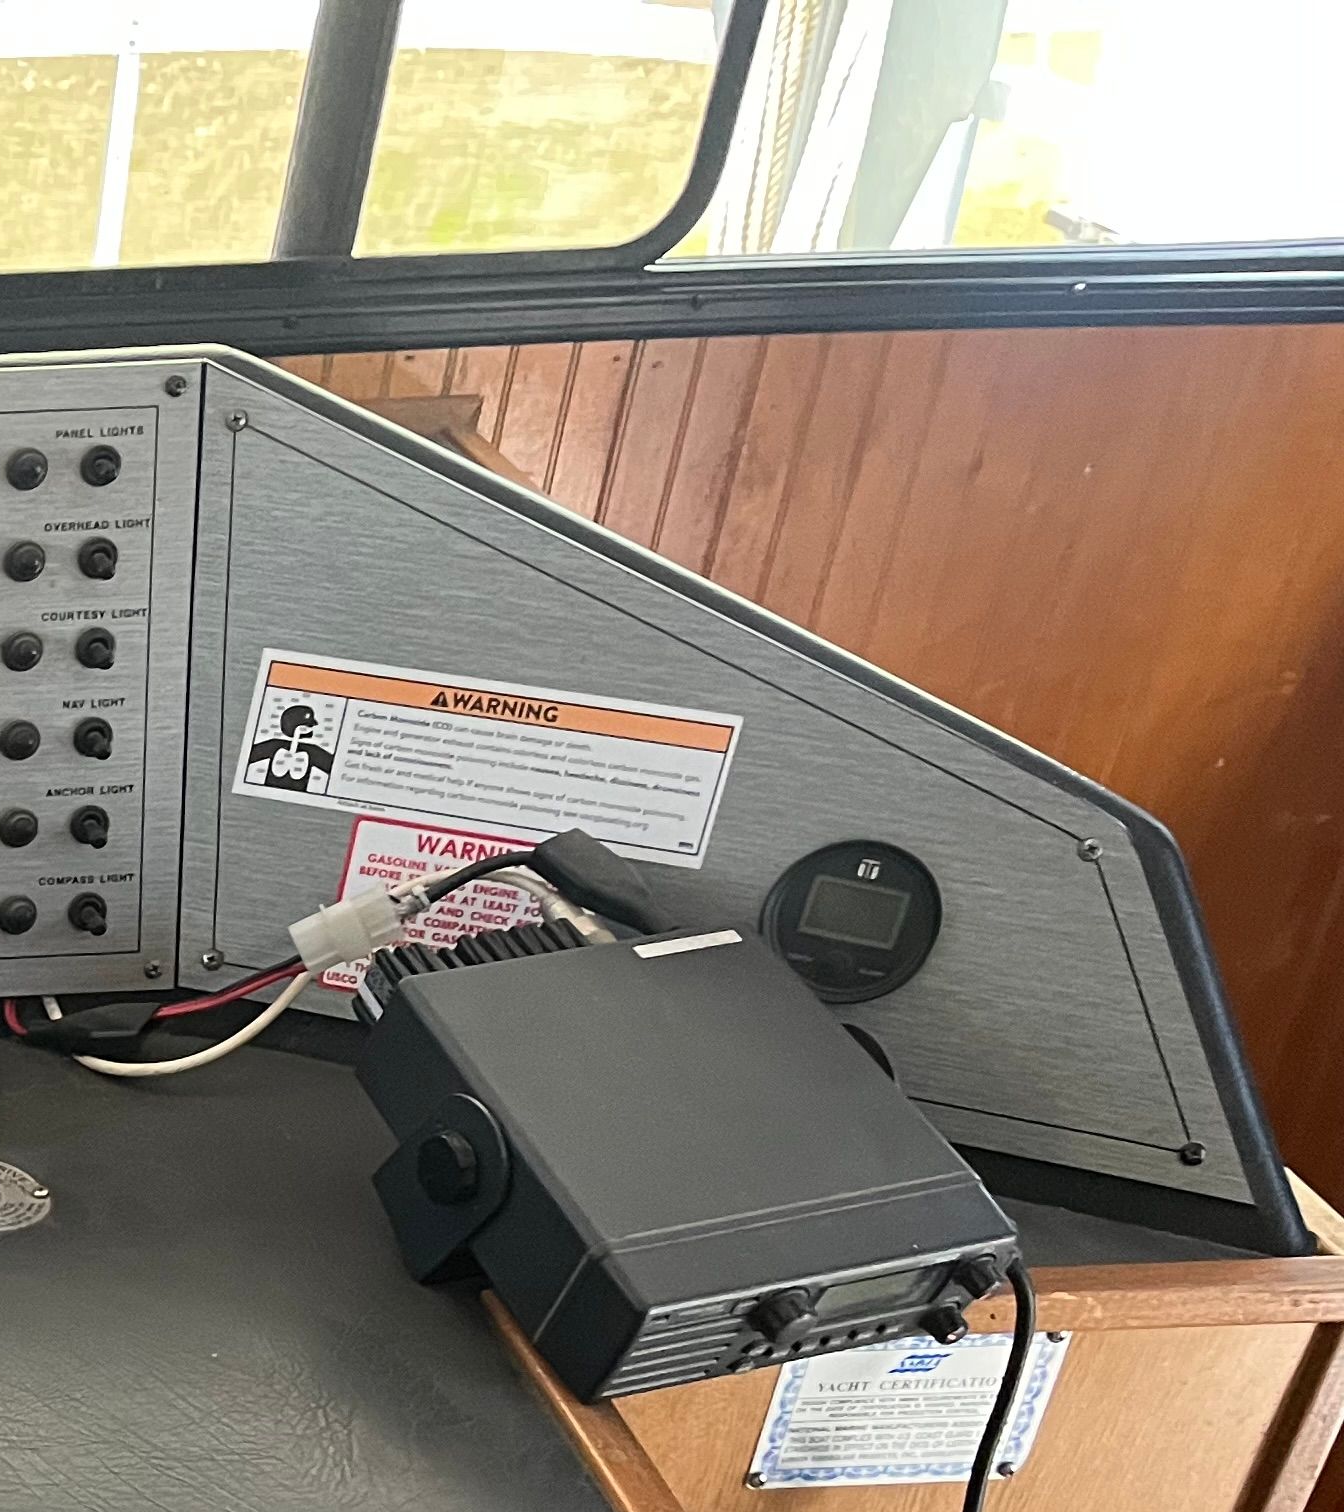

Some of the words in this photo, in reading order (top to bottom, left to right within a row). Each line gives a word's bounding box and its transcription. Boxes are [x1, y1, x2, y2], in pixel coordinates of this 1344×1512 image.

[56, 429, 93, 438] PANEL
[100, 426, 144, 437] LIGHTS
[44, 520, 109, 532] OVERHEAD
[115, 519, 150, 529] LIGHT
[41, 611, 105, 621] COURTESY
[112, 608, 147, 618] LIGHT
[62, 700, 85, 709] NAV
[91, 698, 125, 708] LIGHT
[453, 692, 559, 722] WARNING
[46, 787, 94, 797] ANCHOR
[100, 785, 134, 795] LIGHT
[418, 834, 512, 861] WARN
[368, 854, 427, 871] GASOLINE
[38, 876, 94, 886] COMPASS
[100, 873, 135, 883] LIGHT
[360, 866, 401, 880] BEFORE
[462, 898, 476, 906] AT
[483, 901, 517, 913] LEAST
[437, 907, 463, 917] AND
[470, 912, 510, 925] CHECK
[818, 1382, 870, 1392] YACHT
[880, 1377, 997, 1389] CERTIFICATIO
